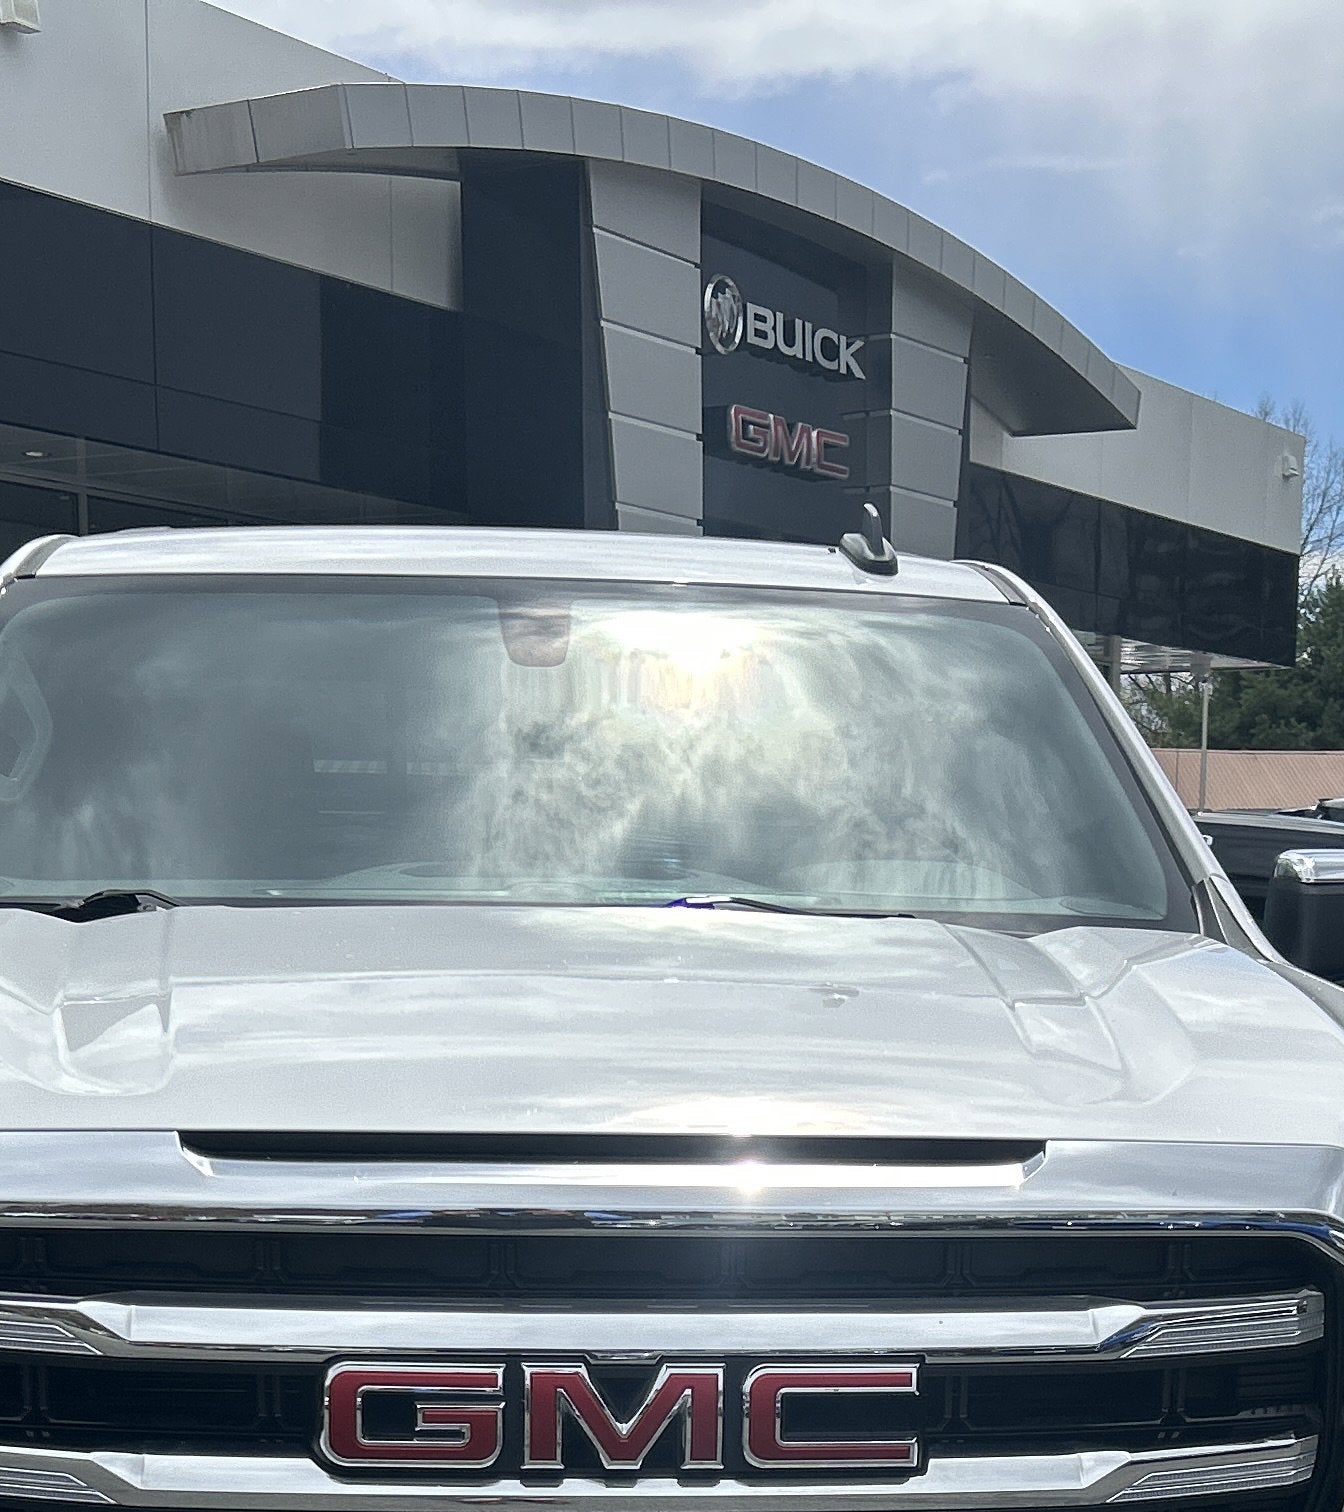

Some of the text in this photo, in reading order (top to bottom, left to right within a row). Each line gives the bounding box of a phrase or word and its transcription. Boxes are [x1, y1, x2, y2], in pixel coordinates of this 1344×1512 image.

[746, 302, 866, 380] BUICK
[730, 403, 850, 480] GMC
[321, 1361, 920, 1470] GMC
